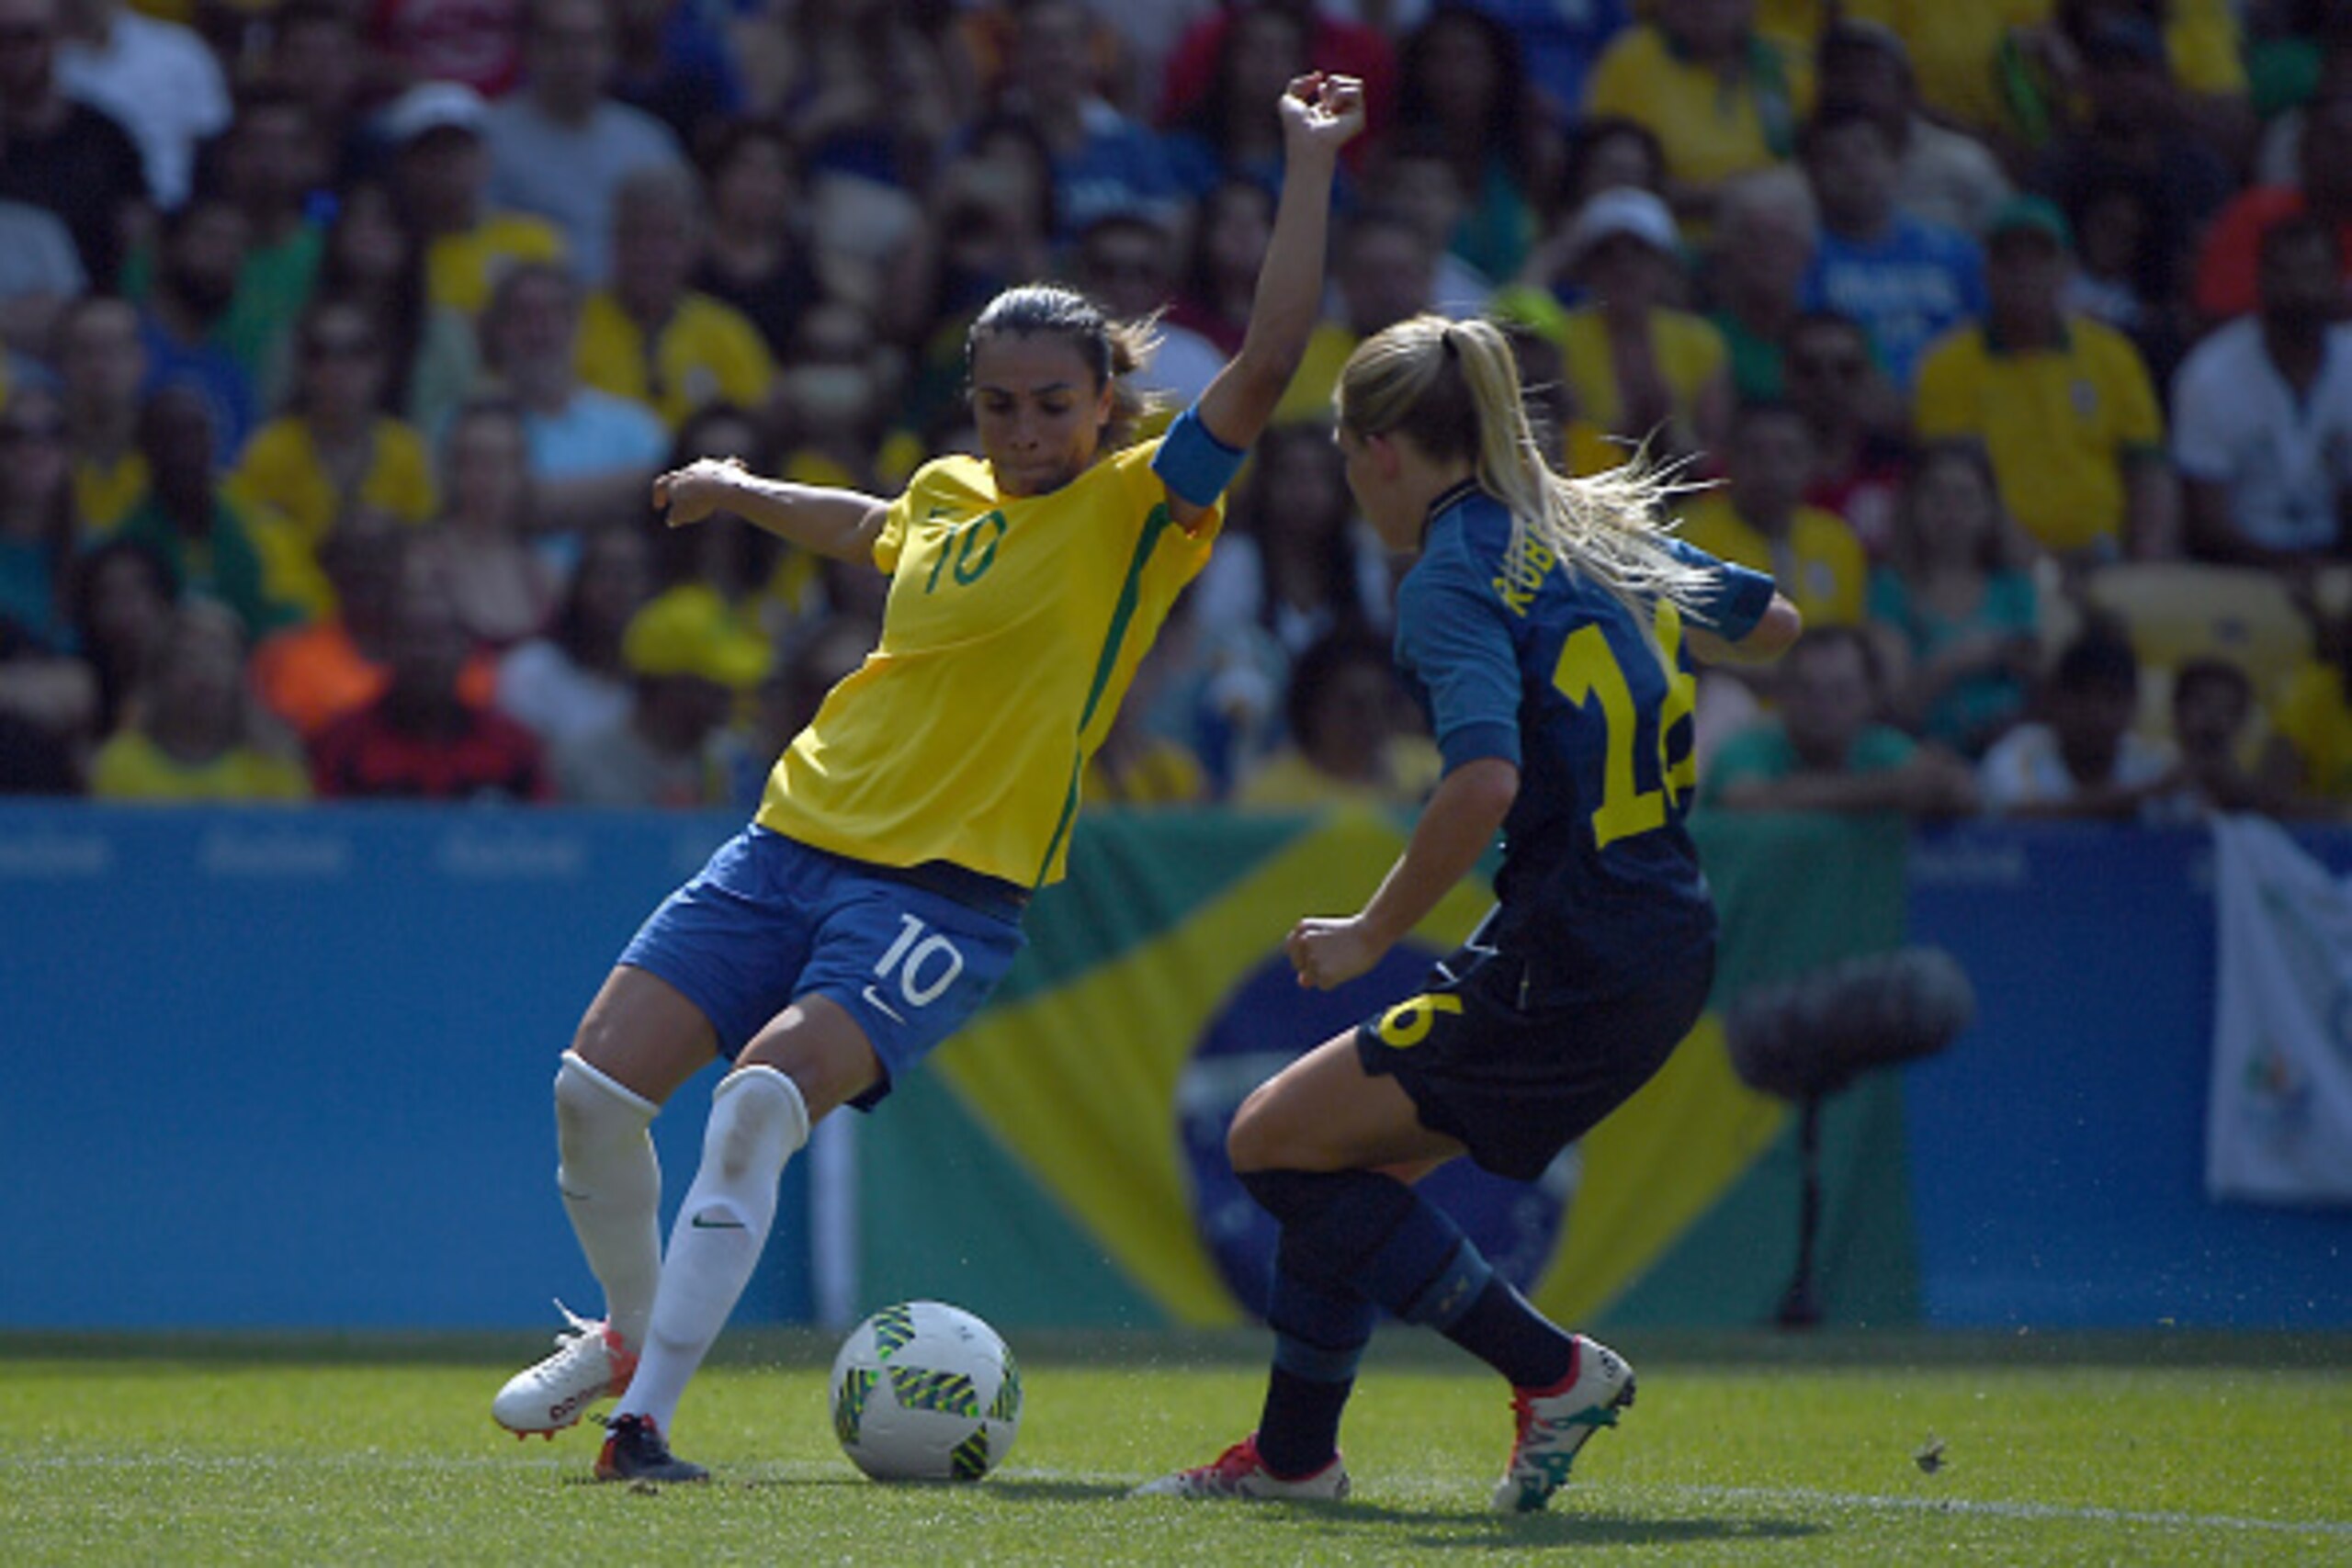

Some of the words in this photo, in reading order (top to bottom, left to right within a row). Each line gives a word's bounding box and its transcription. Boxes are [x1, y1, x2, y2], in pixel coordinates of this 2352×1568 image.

[925, 509, 1007, 593] 10
[874, 912, 964, 1007] 10
[1379, 992, 1465, 1050] 6
